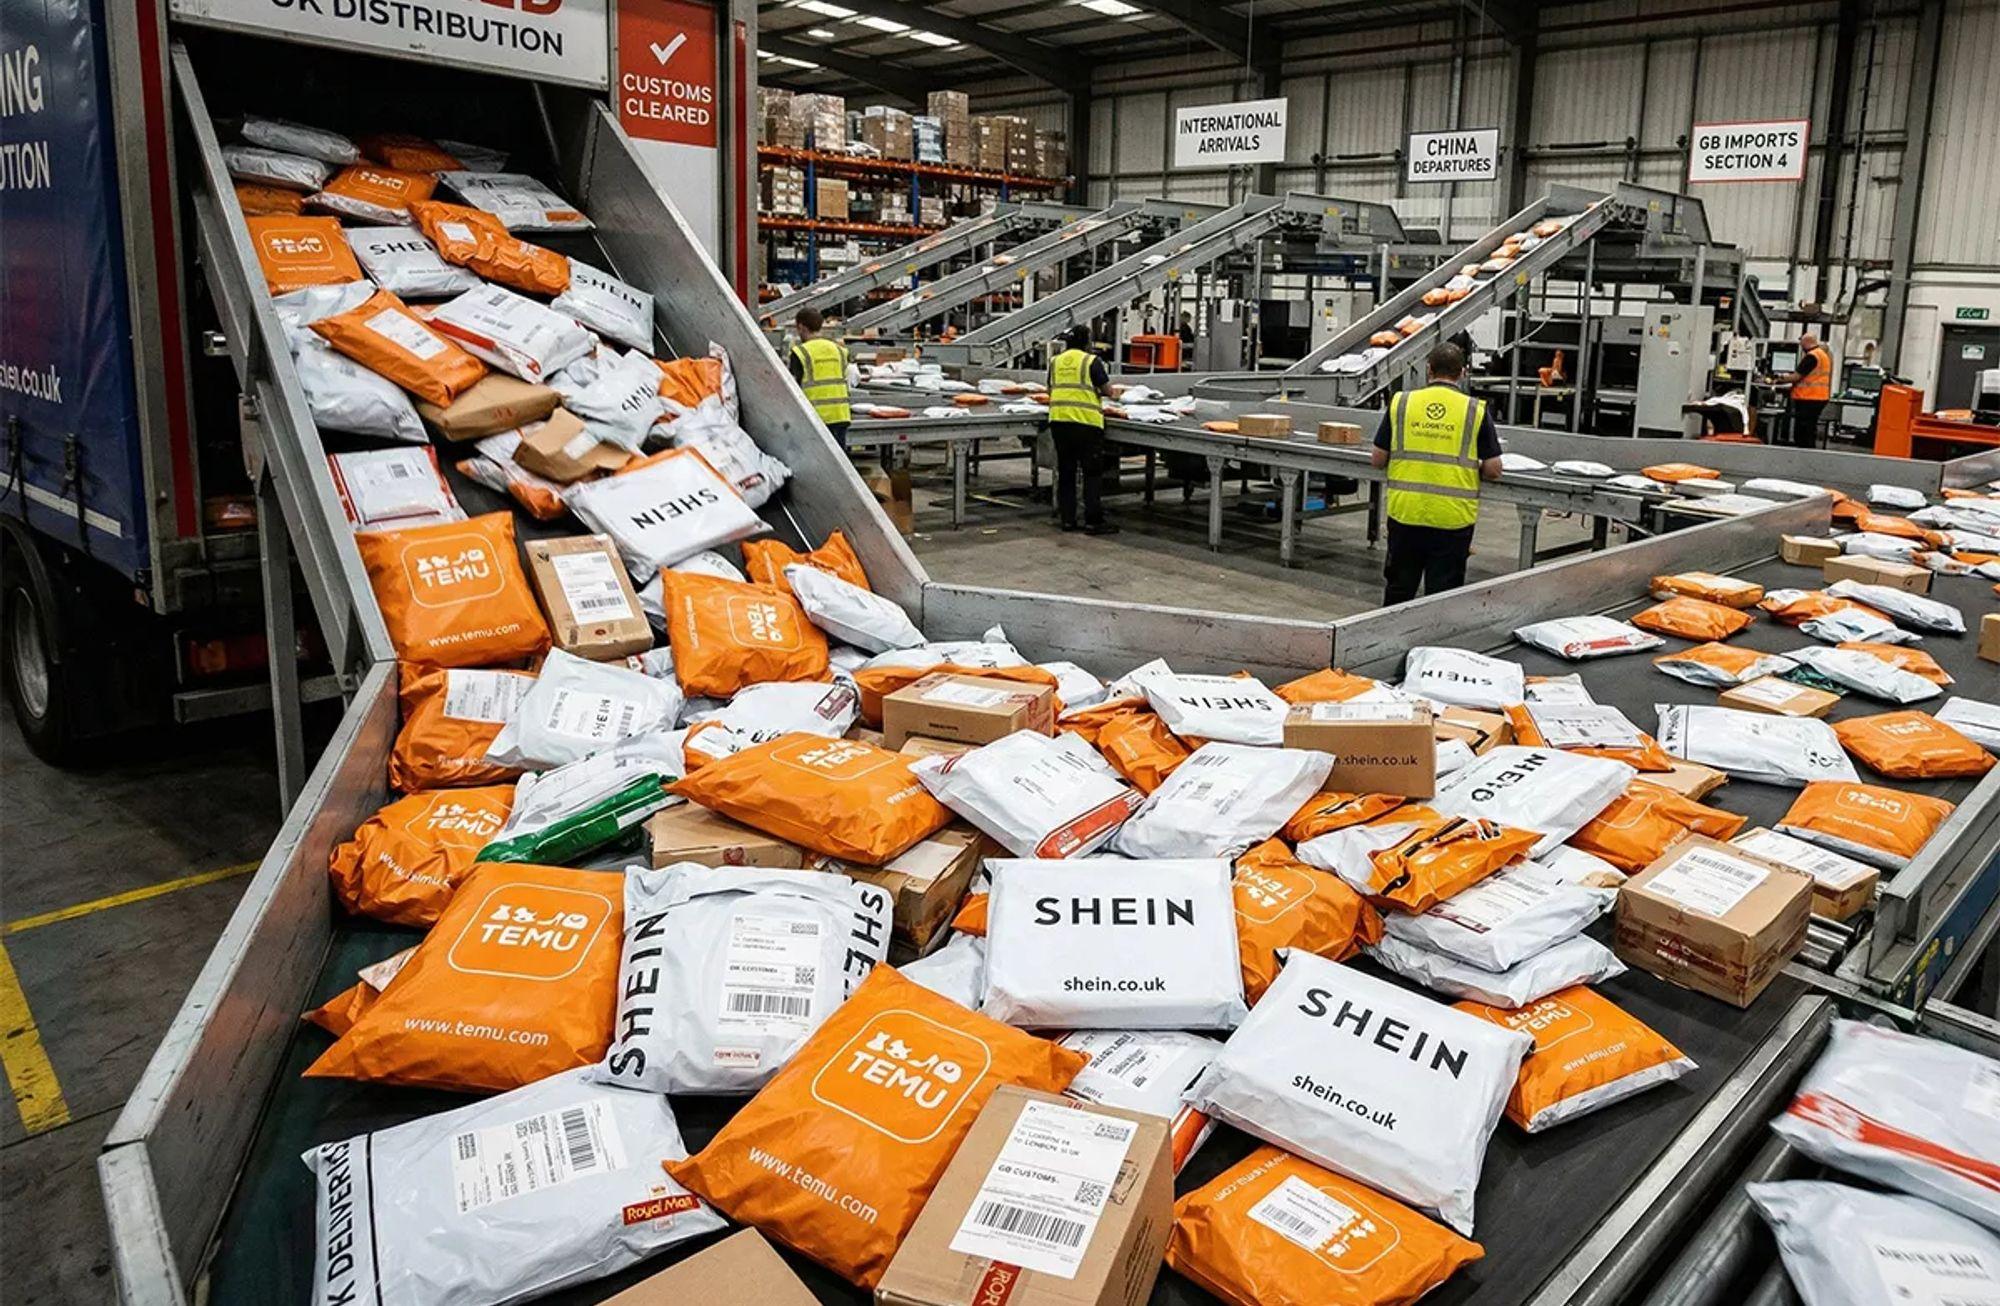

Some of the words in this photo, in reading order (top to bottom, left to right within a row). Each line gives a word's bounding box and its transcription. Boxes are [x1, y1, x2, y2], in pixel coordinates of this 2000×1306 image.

[333, 0, 563, 56] DISTRIBUTION
[622, 73, 712, 104] CUSTOMS
[625, 97, 710, 126] CLEARED
[1180, 111, 1282, 134] INTERNATIONAL
[1198, 134, 1260, 153] ARRIVALS
[1427, 137, 1478, 156] CHINA
[1699, 135, 1721, 150] GB
[1725, 132, 1798, 149] IMPORTS
[1413, 158, 1491, 174] DEPARTURES
[1705, 153, 1773, 169] SECTION
[1777, 152, 1788, 168] 4
[576, 274, 642, 310] SHEIN
[630, 487, 719, 530] SHEIN
[420, 561, 491, 588] TEMU
[428, 623, 521, 648] www.temu.com
[427, 816, 498, 836] TEMU
[1034, 897, 1195, 926] SHEIN
[480, 923, 581, 952] TEMU
[609, 911, 669, 1077] SHEIN
[1063, 976, 1167, 992] shein.co.uk
[404, 1016, 550, 1047] www.temu.com
[1298, 987, 1470, 1080] SHEIN
[845, 1050, 948, 1110] TEMU
[1291, 1072, 1399, 1131] shein.co.uk
[747, 1145, 879, 1225] www.temu.com
[626, 1200, 662, 1220] Royal
